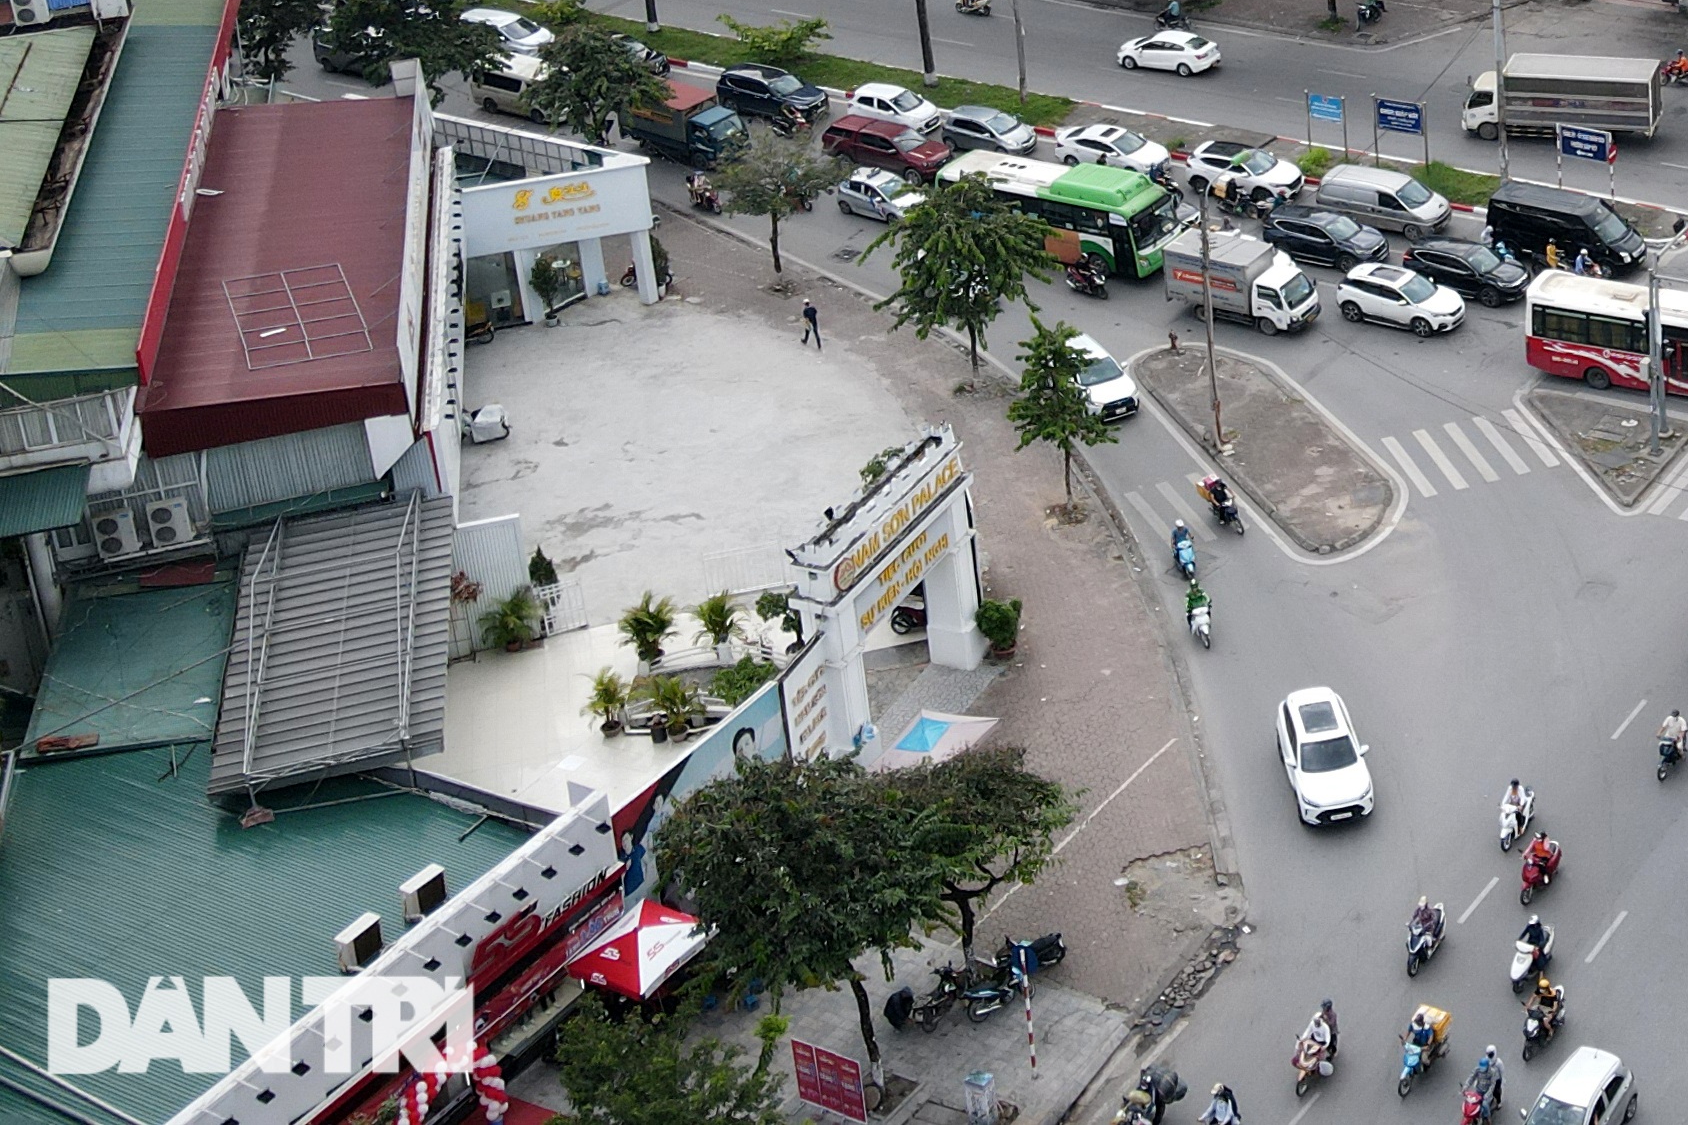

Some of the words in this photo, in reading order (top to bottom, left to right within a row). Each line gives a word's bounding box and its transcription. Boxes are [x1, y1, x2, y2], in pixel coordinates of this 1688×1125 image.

[851, 533, 881, 571] NAM
[882, 502, 911, 542] SƠN
[912, 457, 960, 515] PALACE
[540, 867, 610, 934] FASHION
